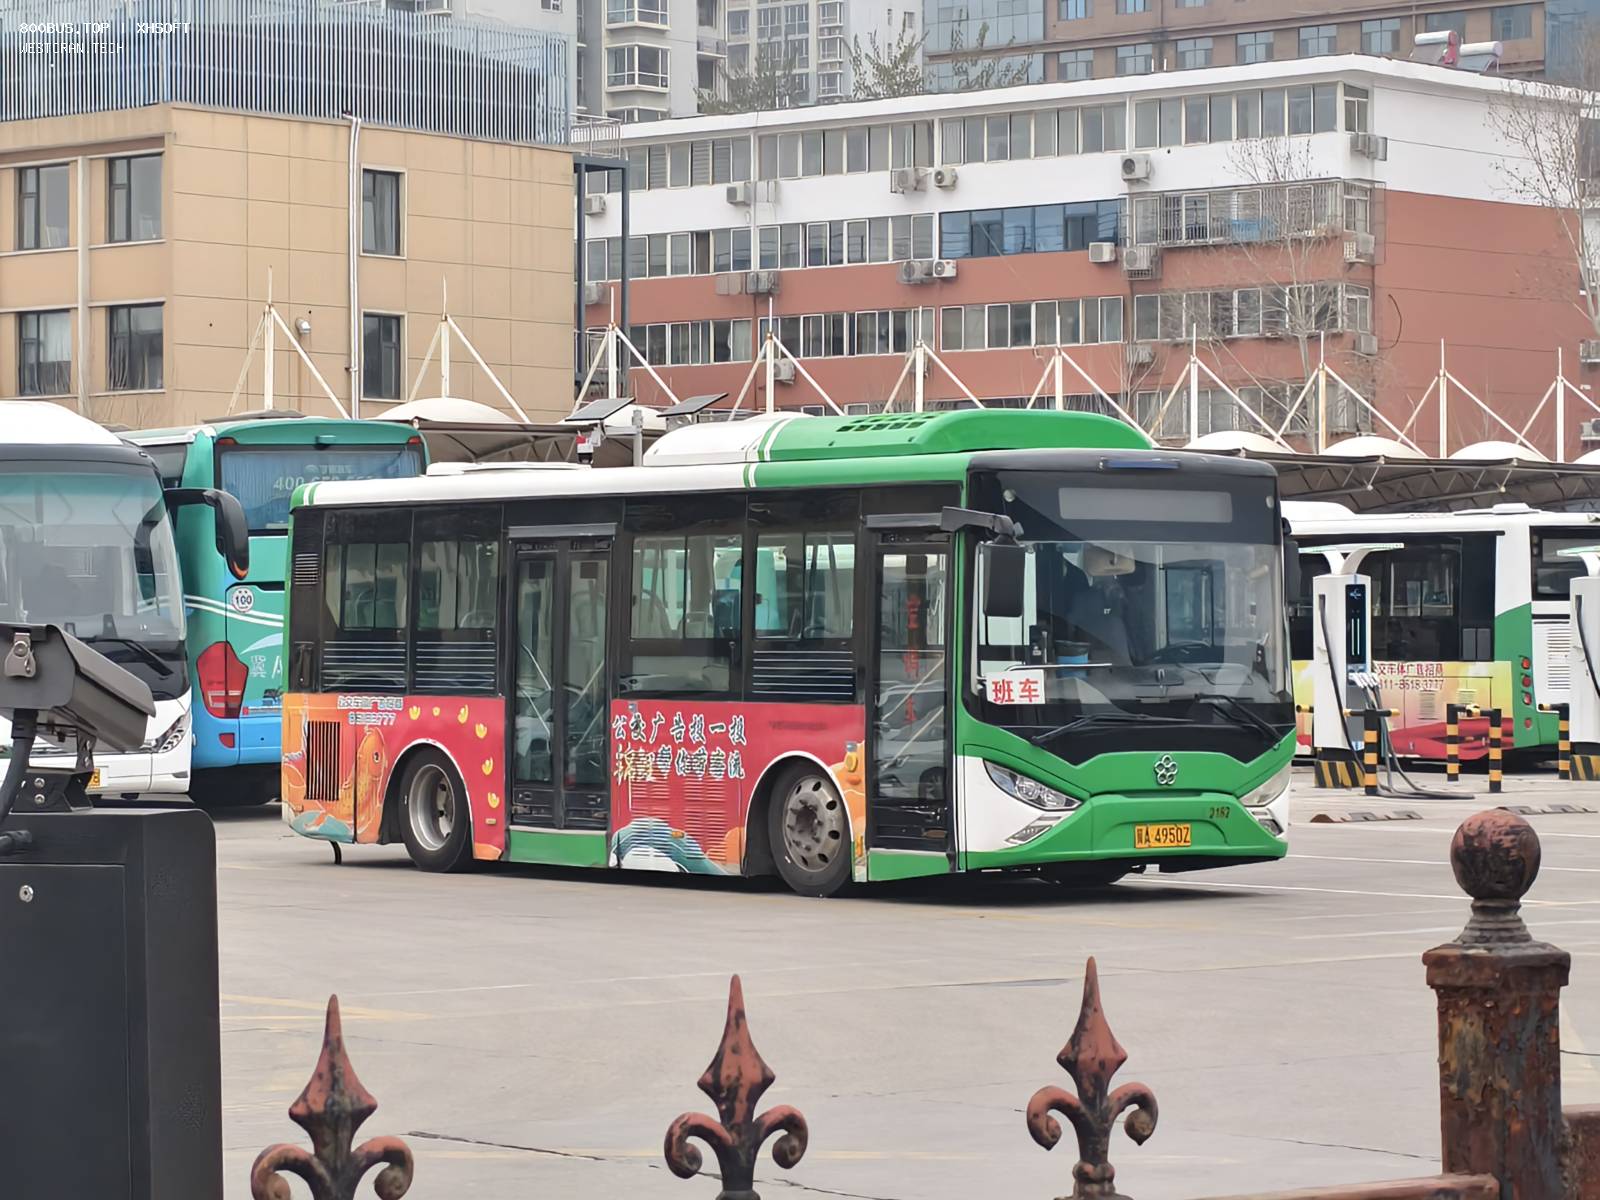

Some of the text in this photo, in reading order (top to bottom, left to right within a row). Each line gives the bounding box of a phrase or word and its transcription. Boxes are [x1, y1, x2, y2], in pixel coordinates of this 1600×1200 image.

[235, 594, 253, 607] 100
[992, 678, 1040, 703] 班车
[612, 711, 747, 745] 公交广告投一投
